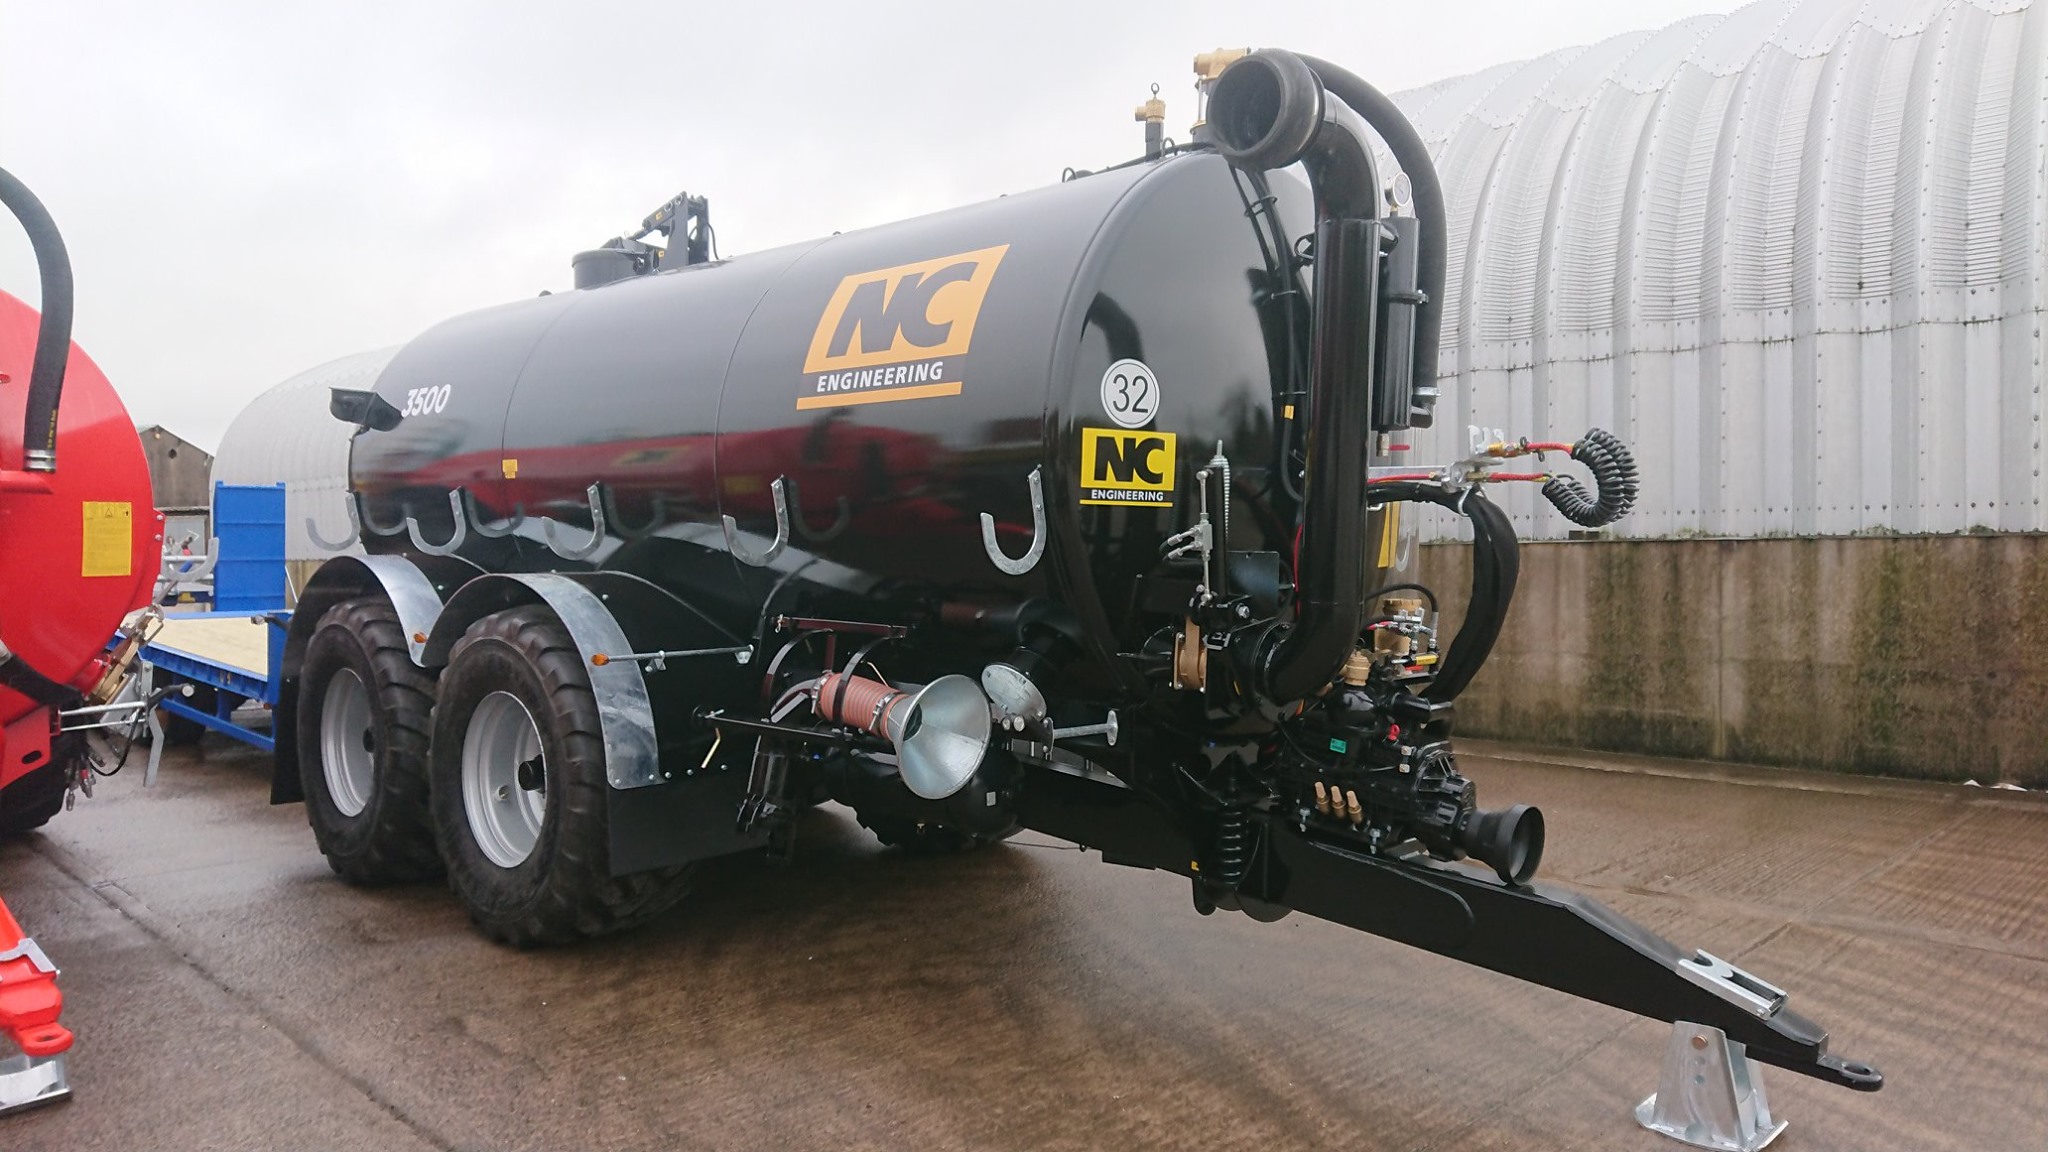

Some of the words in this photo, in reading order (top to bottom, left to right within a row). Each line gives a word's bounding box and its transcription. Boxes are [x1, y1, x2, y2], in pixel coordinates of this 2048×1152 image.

[826, 262, 979, 359] NC
[816, 361, 944, 393] ENGINEERING
[1113, 374, 1149, 413] 32
[401, 384, 451, 418] 3500
[1094, 436, 1166, 485] NC
[1091, 489, 1164, 502] ENGINEERING
